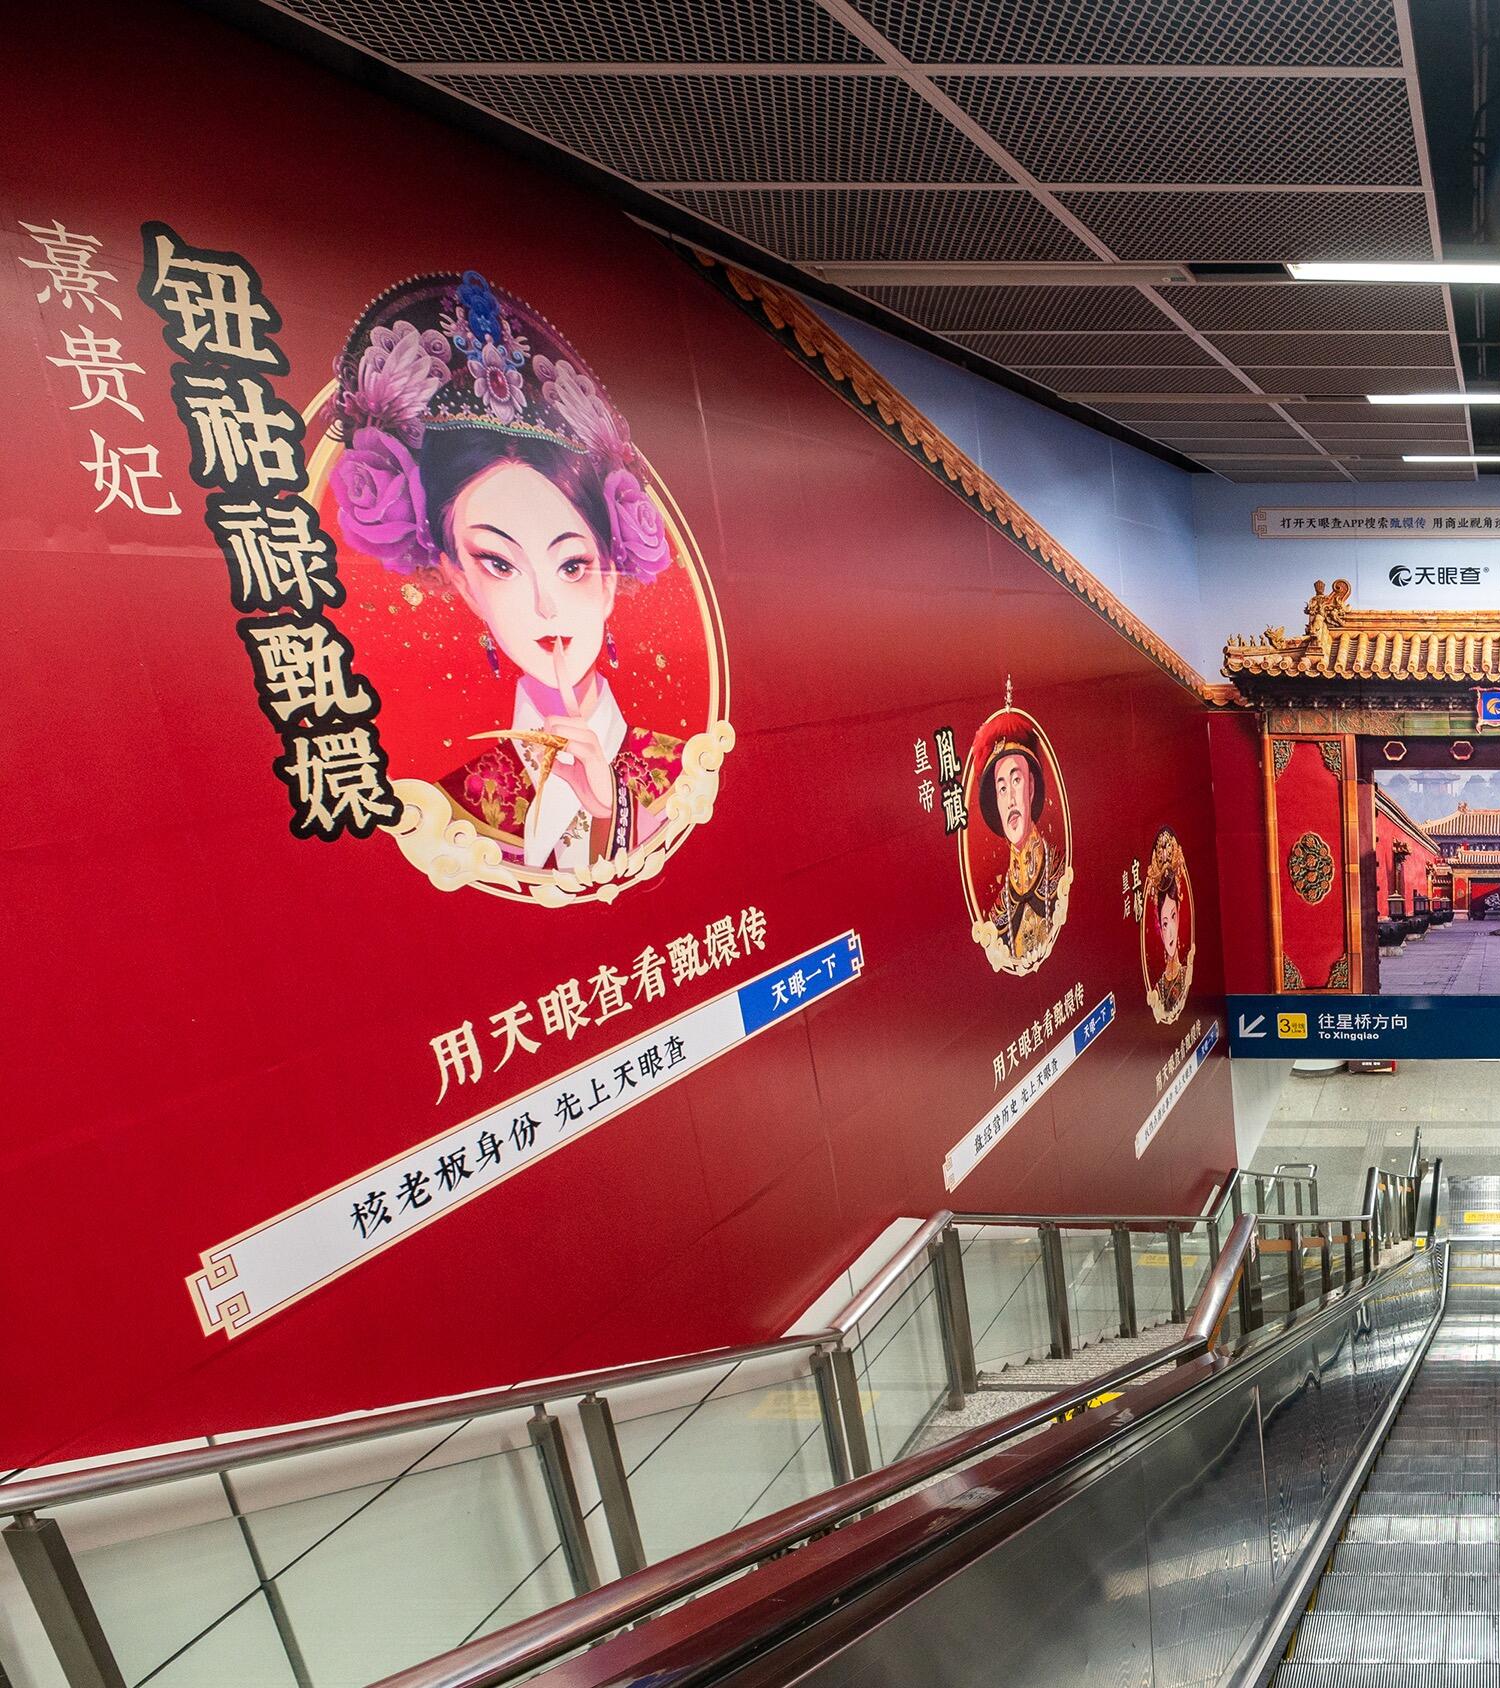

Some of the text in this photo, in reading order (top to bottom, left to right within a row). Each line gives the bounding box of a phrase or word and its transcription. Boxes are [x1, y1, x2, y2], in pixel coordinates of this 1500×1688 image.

[18, 219, 182, 516] 熹贵妃
[150, 231, 398, 835] 钮祜禄甄嬛
[914, 737, 935, 813] 皇帝
[1122, 869, 1130, 920] 皇后
[428, 905, 768, 1105] 用天眼查看甄嬛传
[770, 953, 837, 1011] 天眼一下
[992, 982, 1085, 1092] 用天眼查看甄嬛传
[1083, 1006, 1106, 1043] 天眼一下
[1280, 1018, 1291, 1033] 3
[1318, 1013, 1408, 1030] 往星桥方向
[1319, 1031, 1379, 1041] To Xingqiao
[349, 1034, 686, 1239] 核老板身份 先上天眼查
[974, 1057, 1058, 1156] 盘经营历史 先上天眼查
